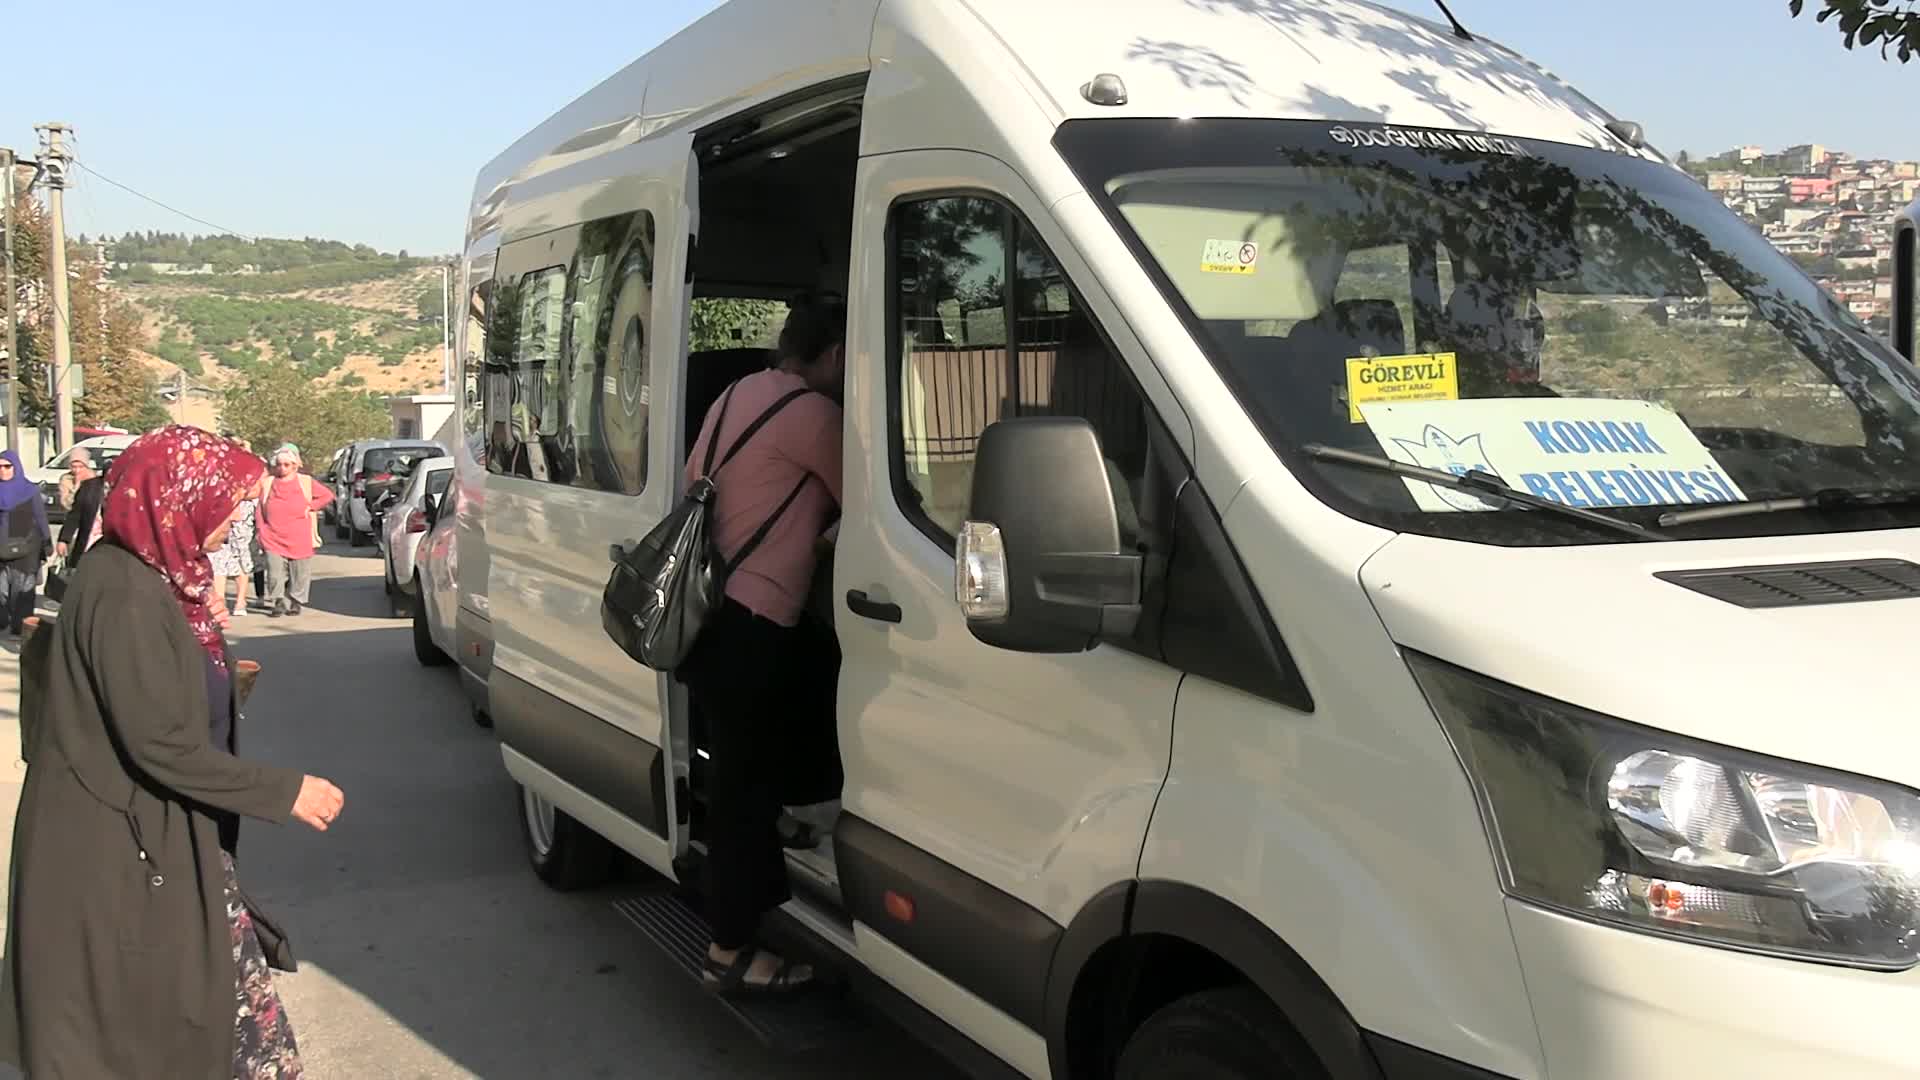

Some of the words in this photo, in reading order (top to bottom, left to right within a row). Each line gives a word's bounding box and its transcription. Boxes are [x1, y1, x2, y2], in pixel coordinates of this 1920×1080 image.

[1353, 126, 1462, 151] DOĞUKAN
[1359, 359, 1445, 384] GÖREVLİ
[1523, 420, 1667, 454] KONAK
[1519, 462, 1742, 508] BELEDİYESİ
